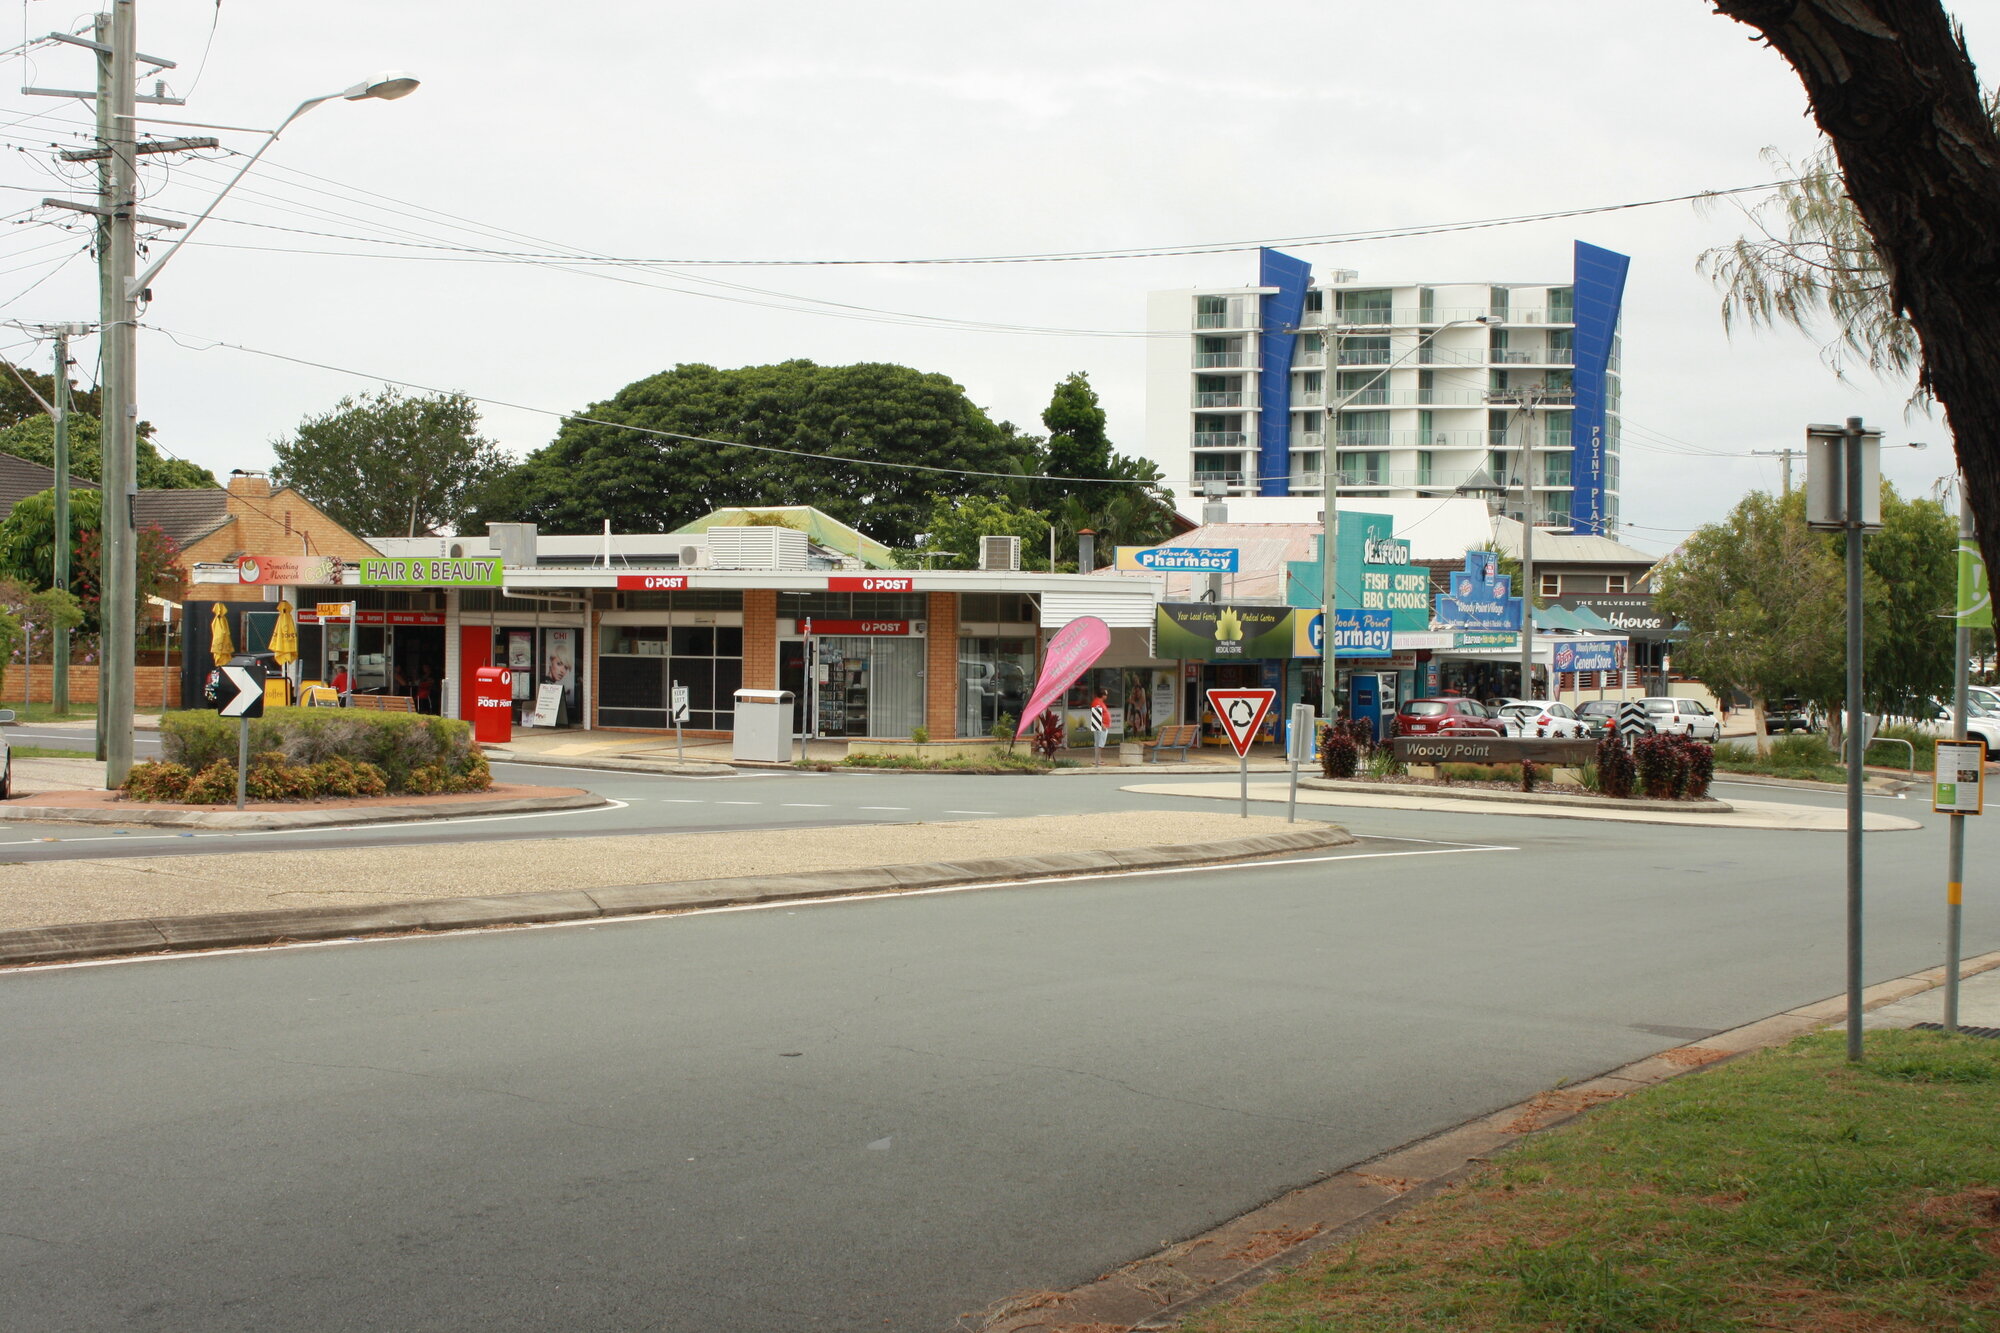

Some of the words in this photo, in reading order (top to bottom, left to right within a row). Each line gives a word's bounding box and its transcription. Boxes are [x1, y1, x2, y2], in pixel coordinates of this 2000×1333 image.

[1591, 426, 1600, 481] POINT
[1590, 488, 1599, 536] PLAZ
[1156, 549, 1195, 559] Woody
[1198, 549, 1233, 558] Point
[1142, 554, 1231, 570] Pharmacy
[366, 561, 406, 581] HAIR
[411, 561, 425, 581] &
[430, 561, 496, 581] BEAUTY
[655, 577, 683, 588] POST
[875, 579, 909, 590] POST
[1365, 573, 1389, 590] FISH
[1394, 574, 1426, 592] CHIPS
[1363, 591, 1384, 610] BBQ
[1387, 591, 1428, 609] CHOOKS
[872, 622, 901, 632] POST
[1363, 614, 1391, 628] Point
[553, 632, 567, 640] CHI
[1313, 624, 1390, 650] Parmacy
[1574, 653, 1597, 670] General
[1597, 654, 1612, 669] Store
[265, 688, 284, 699] coffee
[477, 699, 499, 707] POST
[1406, 743, 1452, 758] Woody
[1454, 744, 1490, 757] Point
